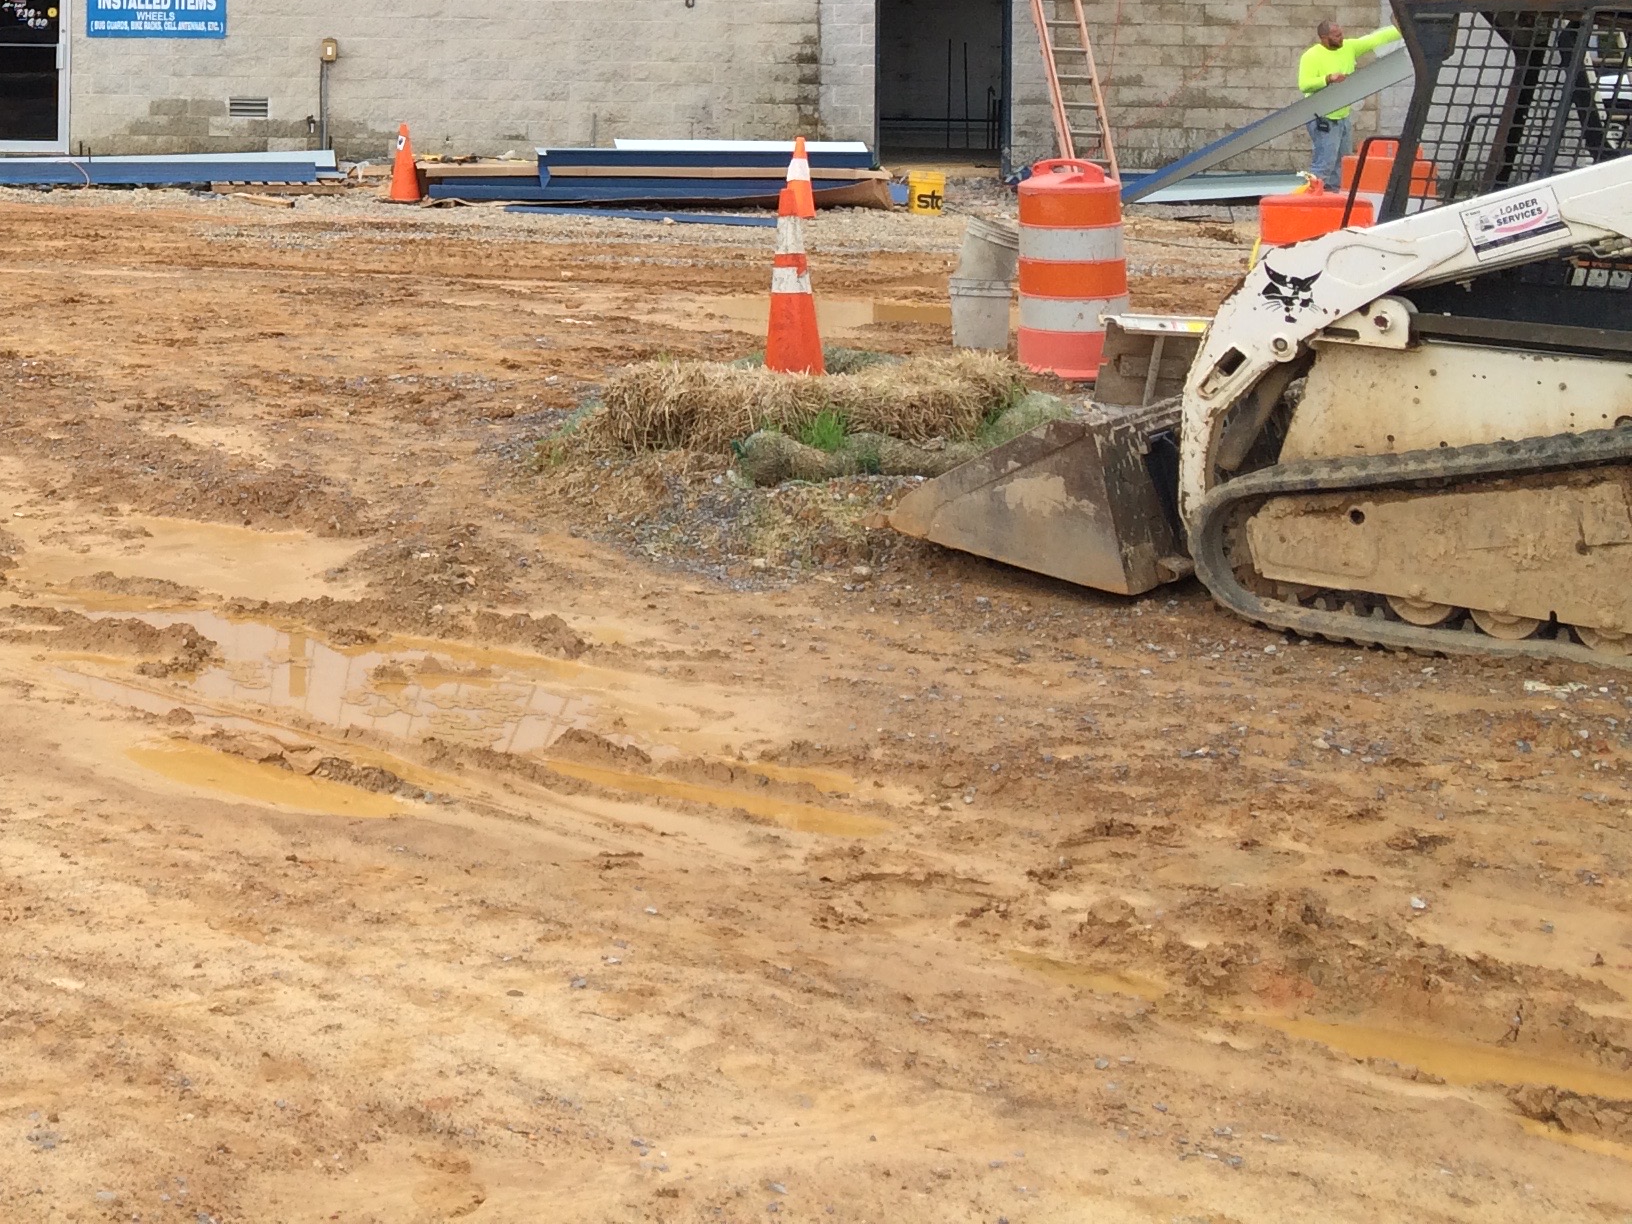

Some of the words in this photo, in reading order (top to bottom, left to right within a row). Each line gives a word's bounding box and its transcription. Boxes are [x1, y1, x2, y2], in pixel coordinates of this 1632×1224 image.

[136, 11, 175, 21] WHEELS
[1496, 206, 1543, 226] SERVICES
[1499, 198, 1539, 216] LOADER
